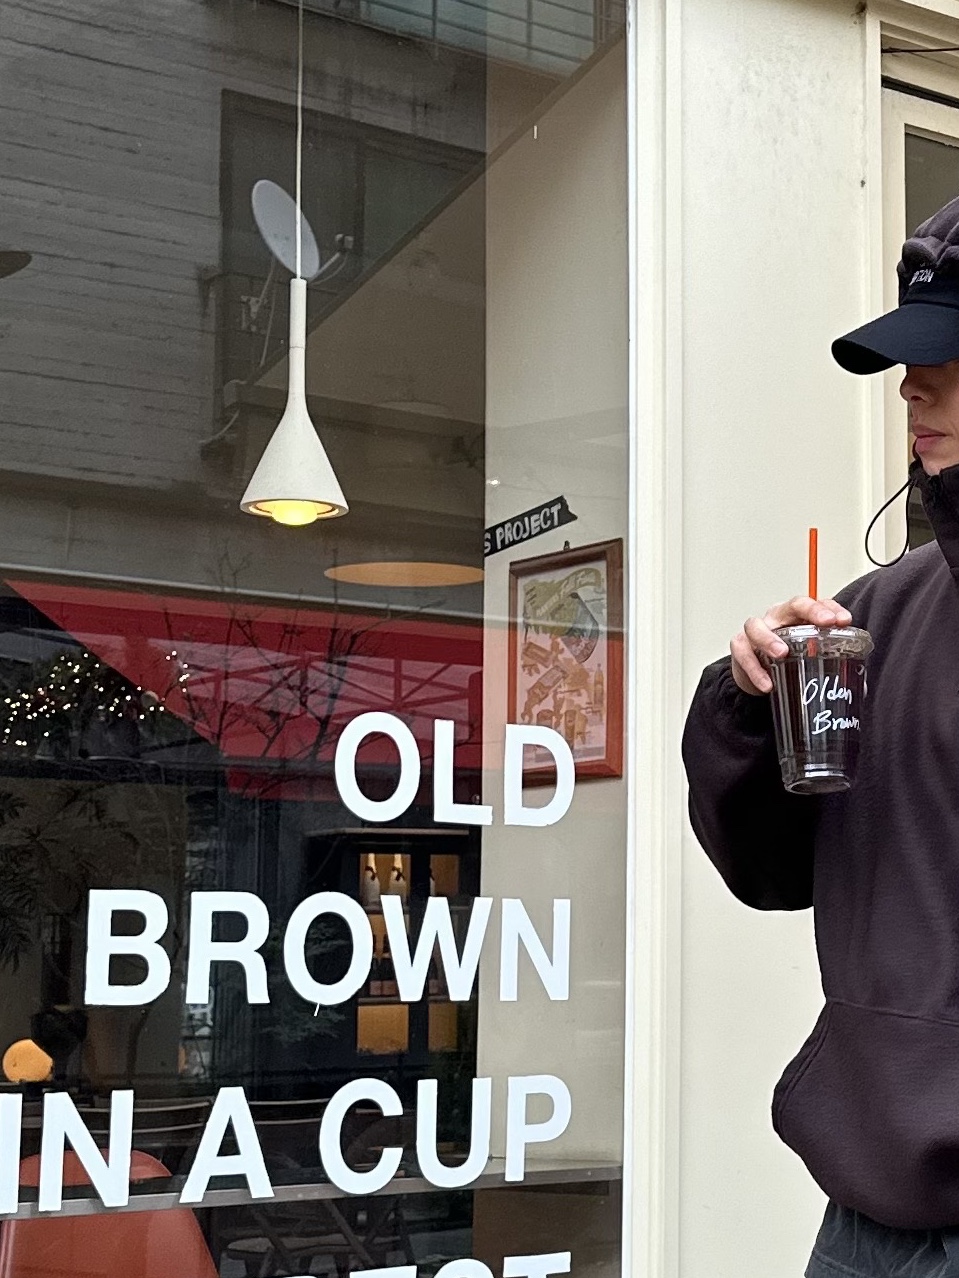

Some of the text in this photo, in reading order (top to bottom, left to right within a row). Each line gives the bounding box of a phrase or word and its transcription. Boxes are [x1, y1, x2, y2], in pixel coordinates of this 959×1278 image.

[495, 503, 561, 550] PROJECT
[334, 711, 576, 827] OLD
[84, 889, 571, 1006] BROWN
[0, 1074, 572, 1214] IN A CUP
